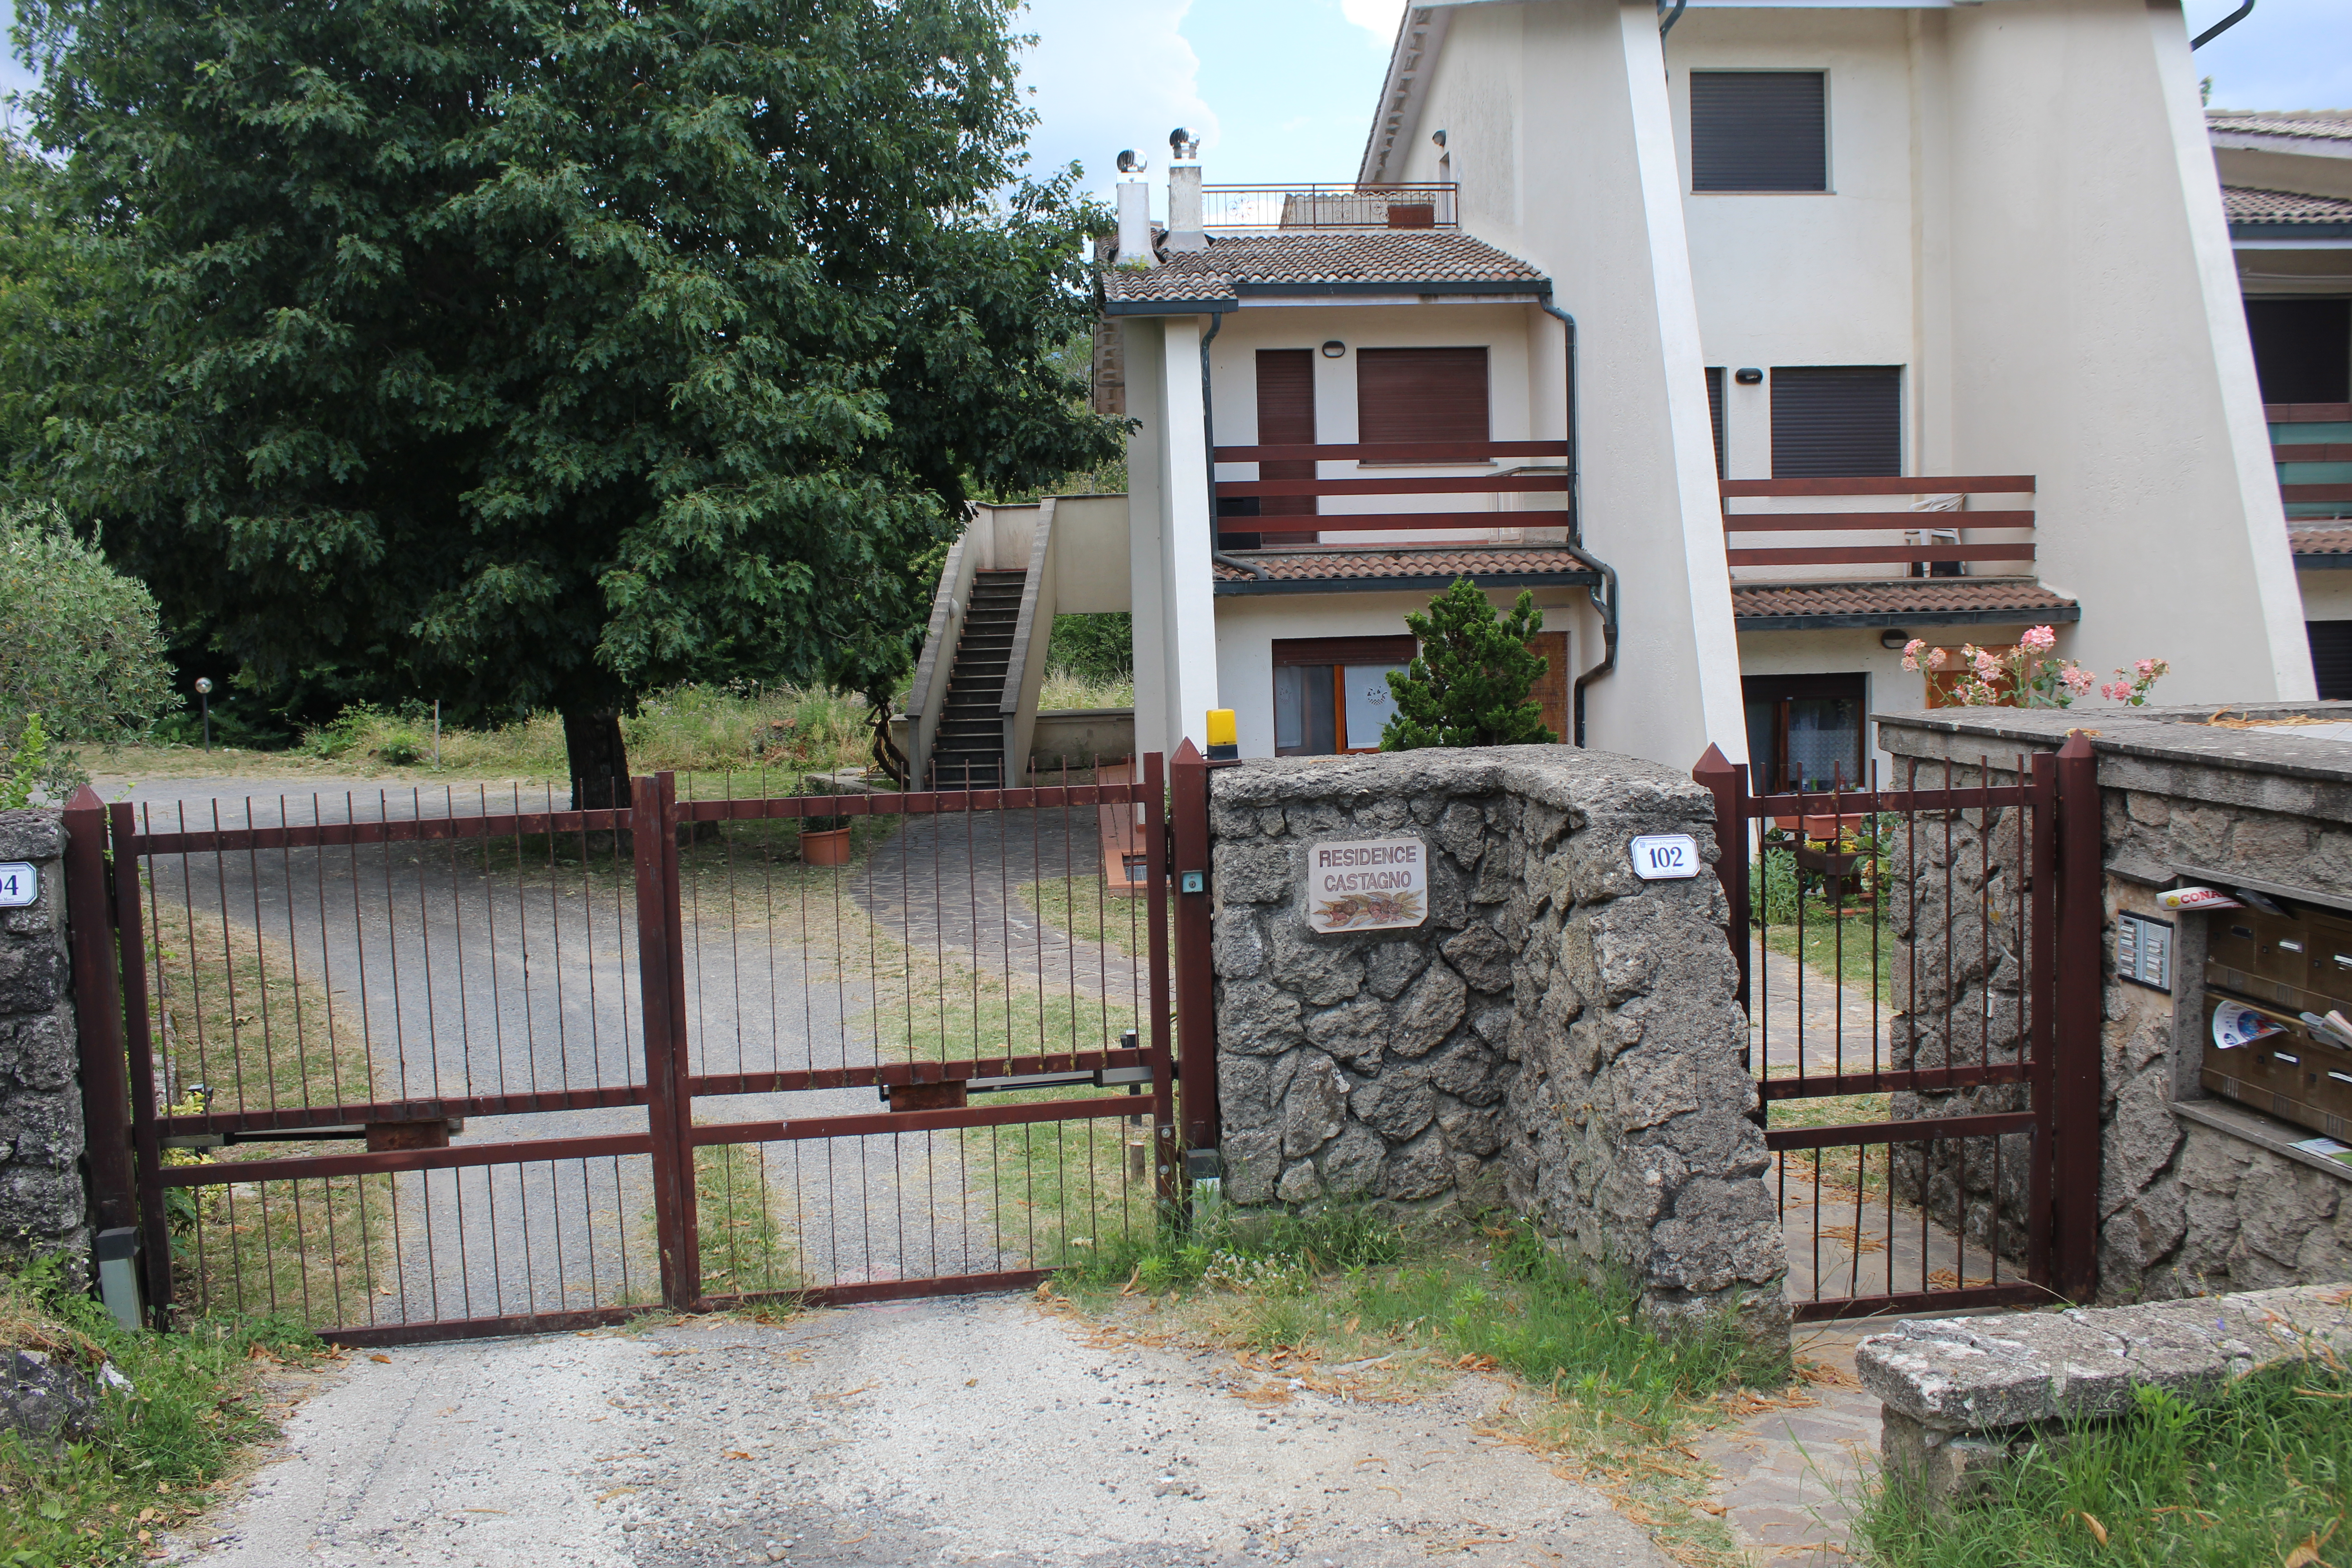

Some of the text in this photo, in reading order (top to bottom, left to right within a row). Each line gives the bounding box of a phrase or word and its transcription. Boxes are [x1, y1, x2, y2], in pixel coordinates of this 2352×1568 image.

[1319, 846, 1416, 867] RESIDENCE
[1649, 847, 1684, 868] 102
[0, 874, 19, 896] 4
[1324, 871, 1411, 892] CASTAGNO
[2180, 891, 2224, 904] CONA
